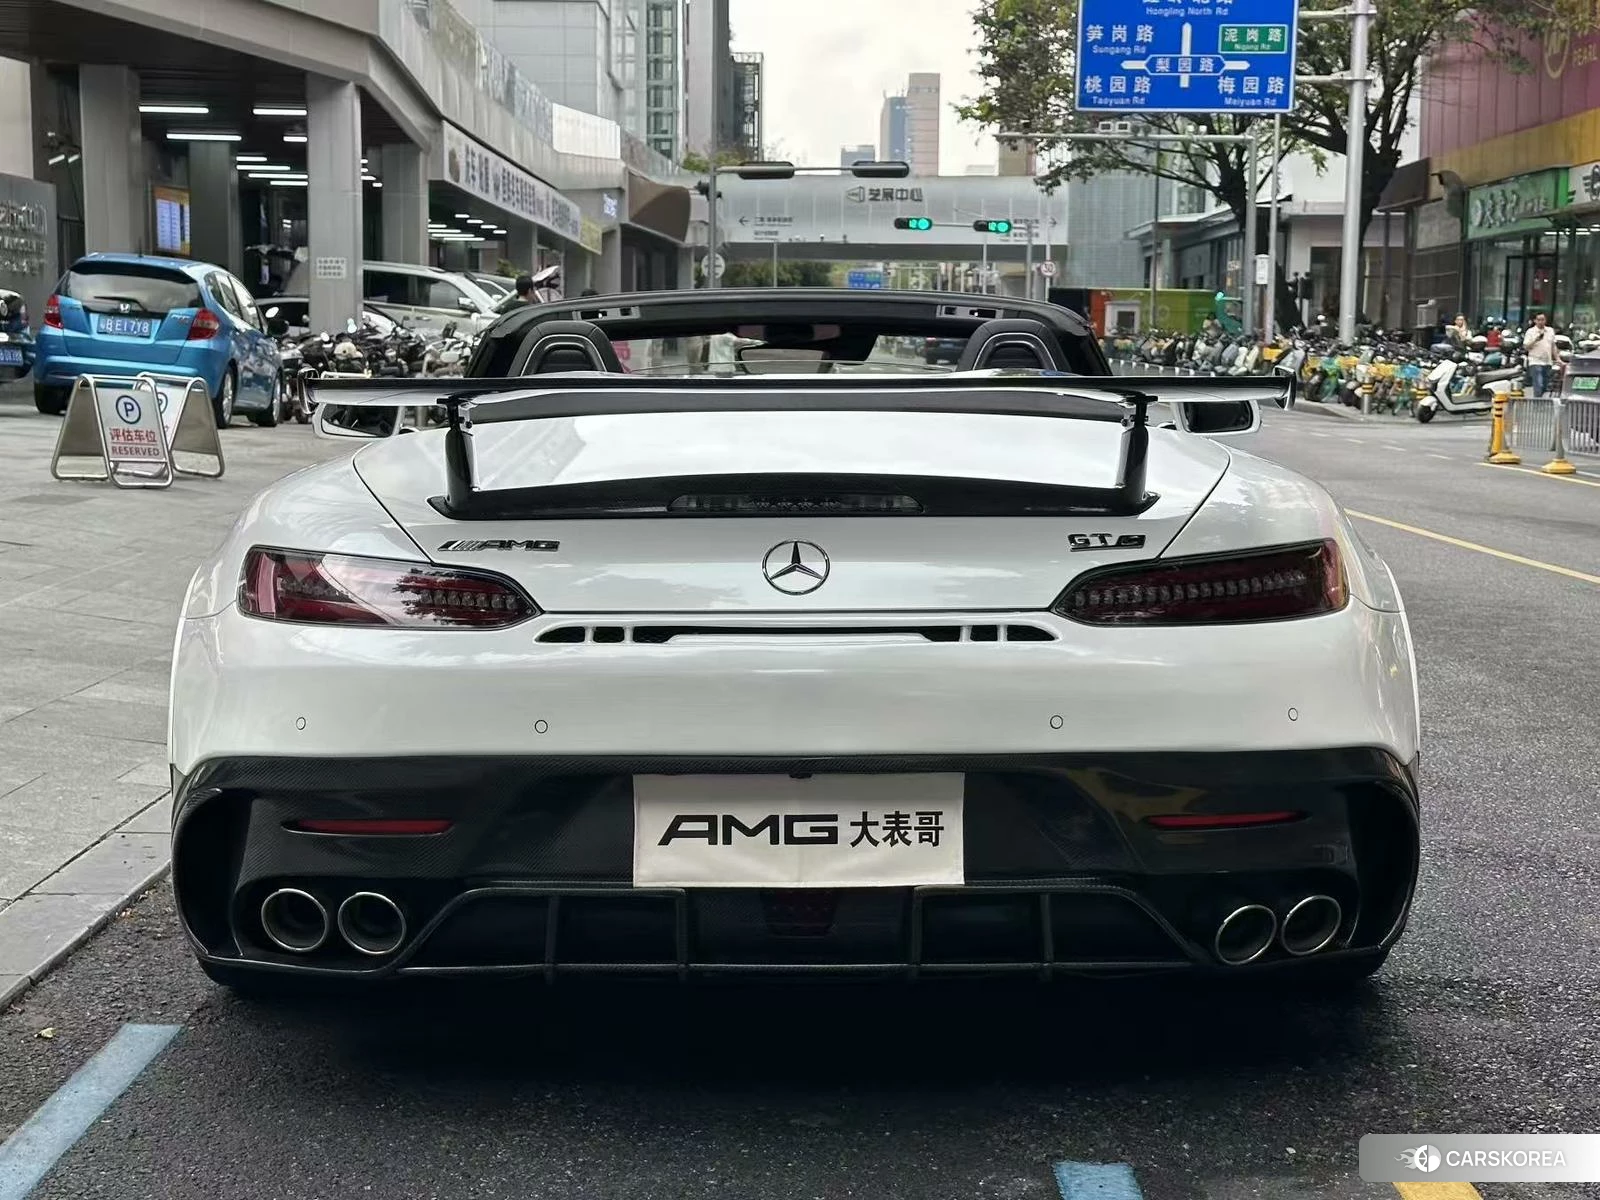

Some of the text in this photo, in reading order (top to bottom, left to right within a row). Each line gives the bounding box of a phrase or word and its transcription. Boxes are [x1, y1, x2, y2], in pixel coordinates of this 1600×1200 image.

[1145, 7, 1229, 17] Hongling North Rd
[1086, 24, 1154, 43] 笋岗路
[1224, 28, 1282, 42] 泥岗路
[1092, 45, 1146, 55] Sungang Rd
[1156, 57, 1214, 73] 梨园路
[1084, 75, 1151, 93] 桃园路
[1218, 76, 1285, 94] 梅园路
[1092, 96, 1145, 106] Taoyuan Rd
[1264, 97, 1277, 106] Rd
[109, 428, 157, 442] 评估车位
[111, 446, 159, 456] RESERVED
[657, 814, 838, 845] AMG
[850, 811, 944, 847] 大表哥
